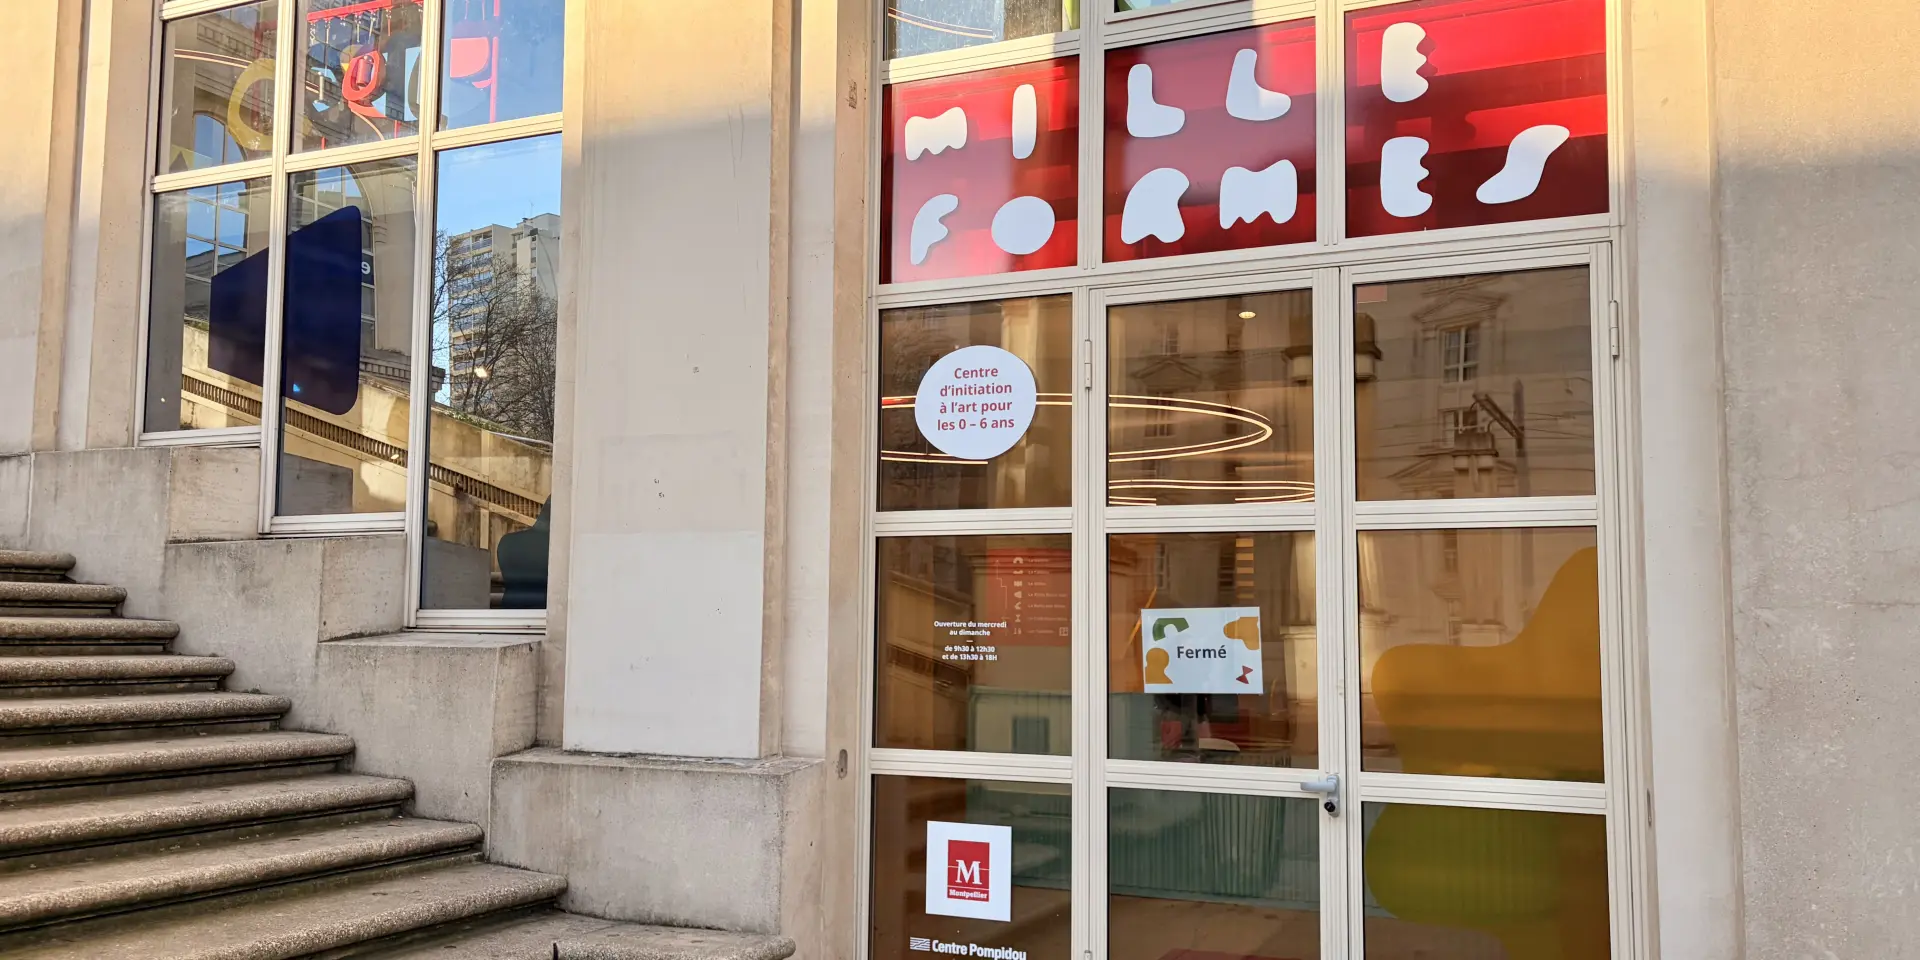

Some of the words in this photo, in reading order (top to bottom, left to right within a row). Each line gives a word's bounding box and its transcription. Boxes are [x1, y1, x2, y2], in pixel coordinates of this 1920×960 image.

[954, 367, 999, 379] Centre
[940, 402, 947, 413] à
[981, 401, 1013, 415] pour
[937, 419, 955, 431] les
[958, 419, 966, 430] 0
[980, 418, 987, 429] 6
[991, 418, 1015, 428] ans
[934, 620, 967, 628] Ouverture
[1177, 645, 1227, 659] Fermé
[955, 860, 982, 885] M
[949, 889, 987, 899] Montpellier
[932, 940, 967, 955] Centre
[969, 943, 1027, 960] Pompidou
